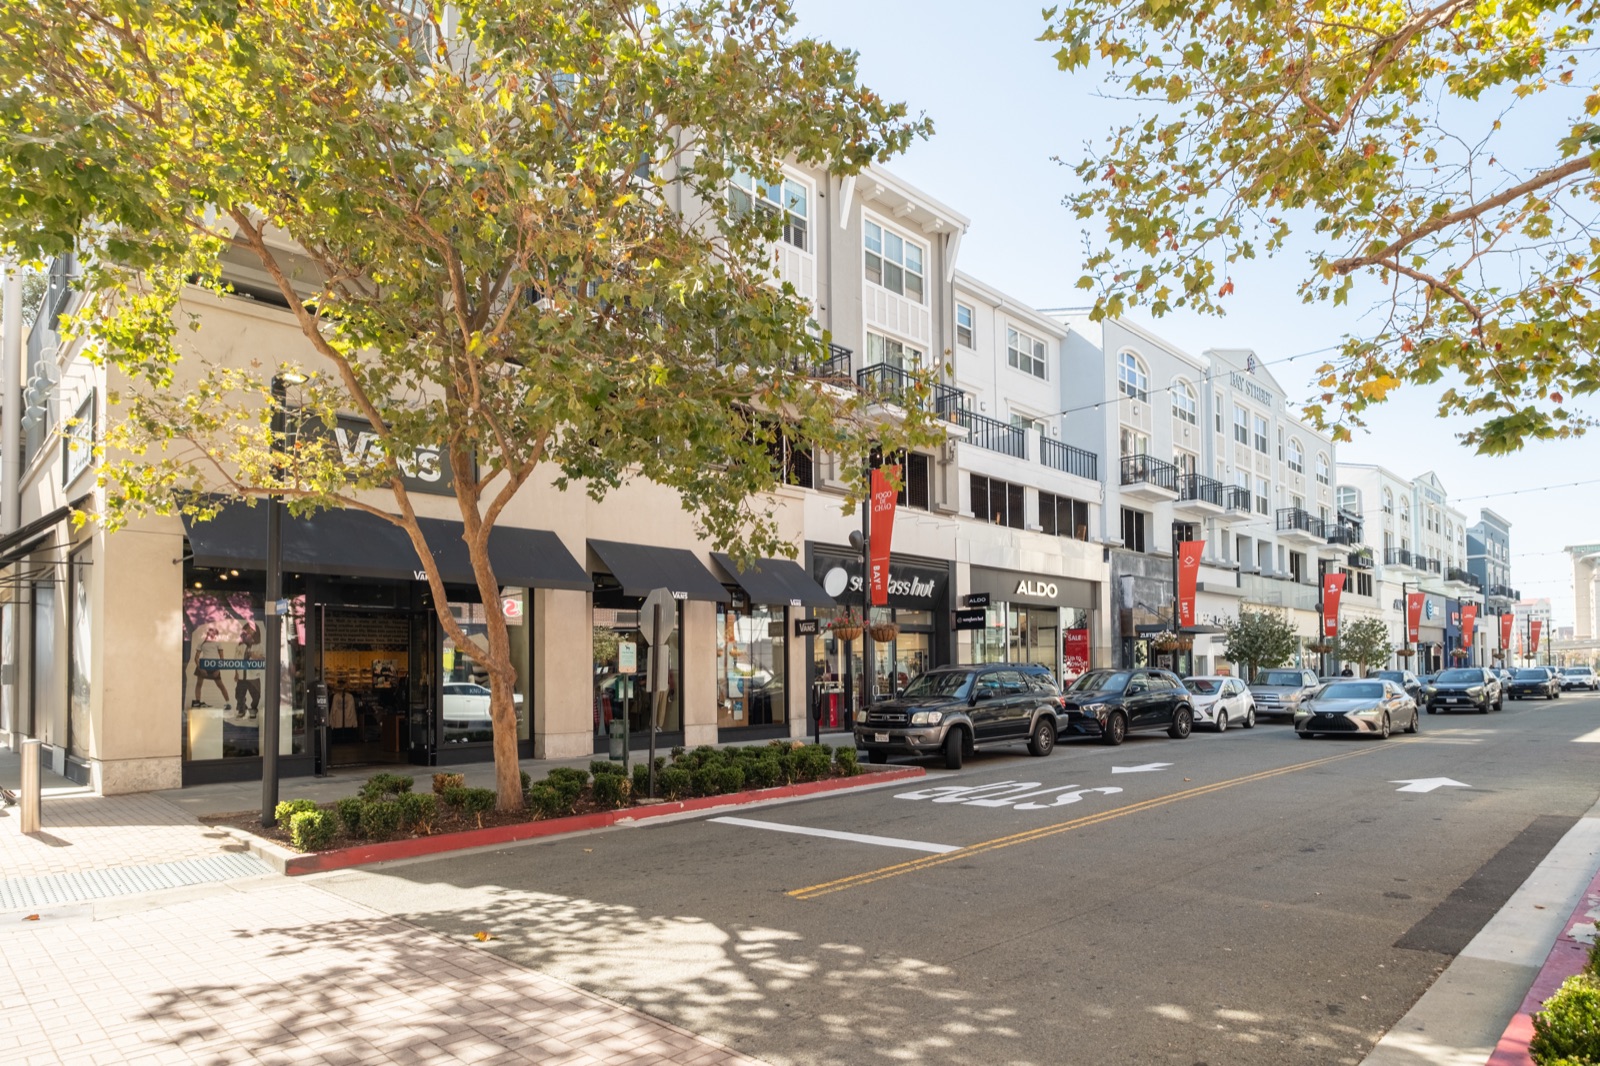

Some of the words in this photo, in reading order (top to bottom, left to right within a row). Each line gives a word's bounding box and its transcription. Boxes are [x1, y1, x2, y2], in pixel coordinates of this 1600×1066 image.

[1230, 370, 1244, 392] BAY
[1246, 380, 1272, 407] STREET
[875, 490, 892, 500] FOGO
[873, 565, 881, 584] BAY
[910, 576, 935, 598] hut
[1016, 579, 1058, 598] ALDO
[672, 591, 688, 600] VANS
[800, 622, 815, 632] VANS
[204, 660, 216, 668] DO
[218, 660, 245, 669] SKOOL
